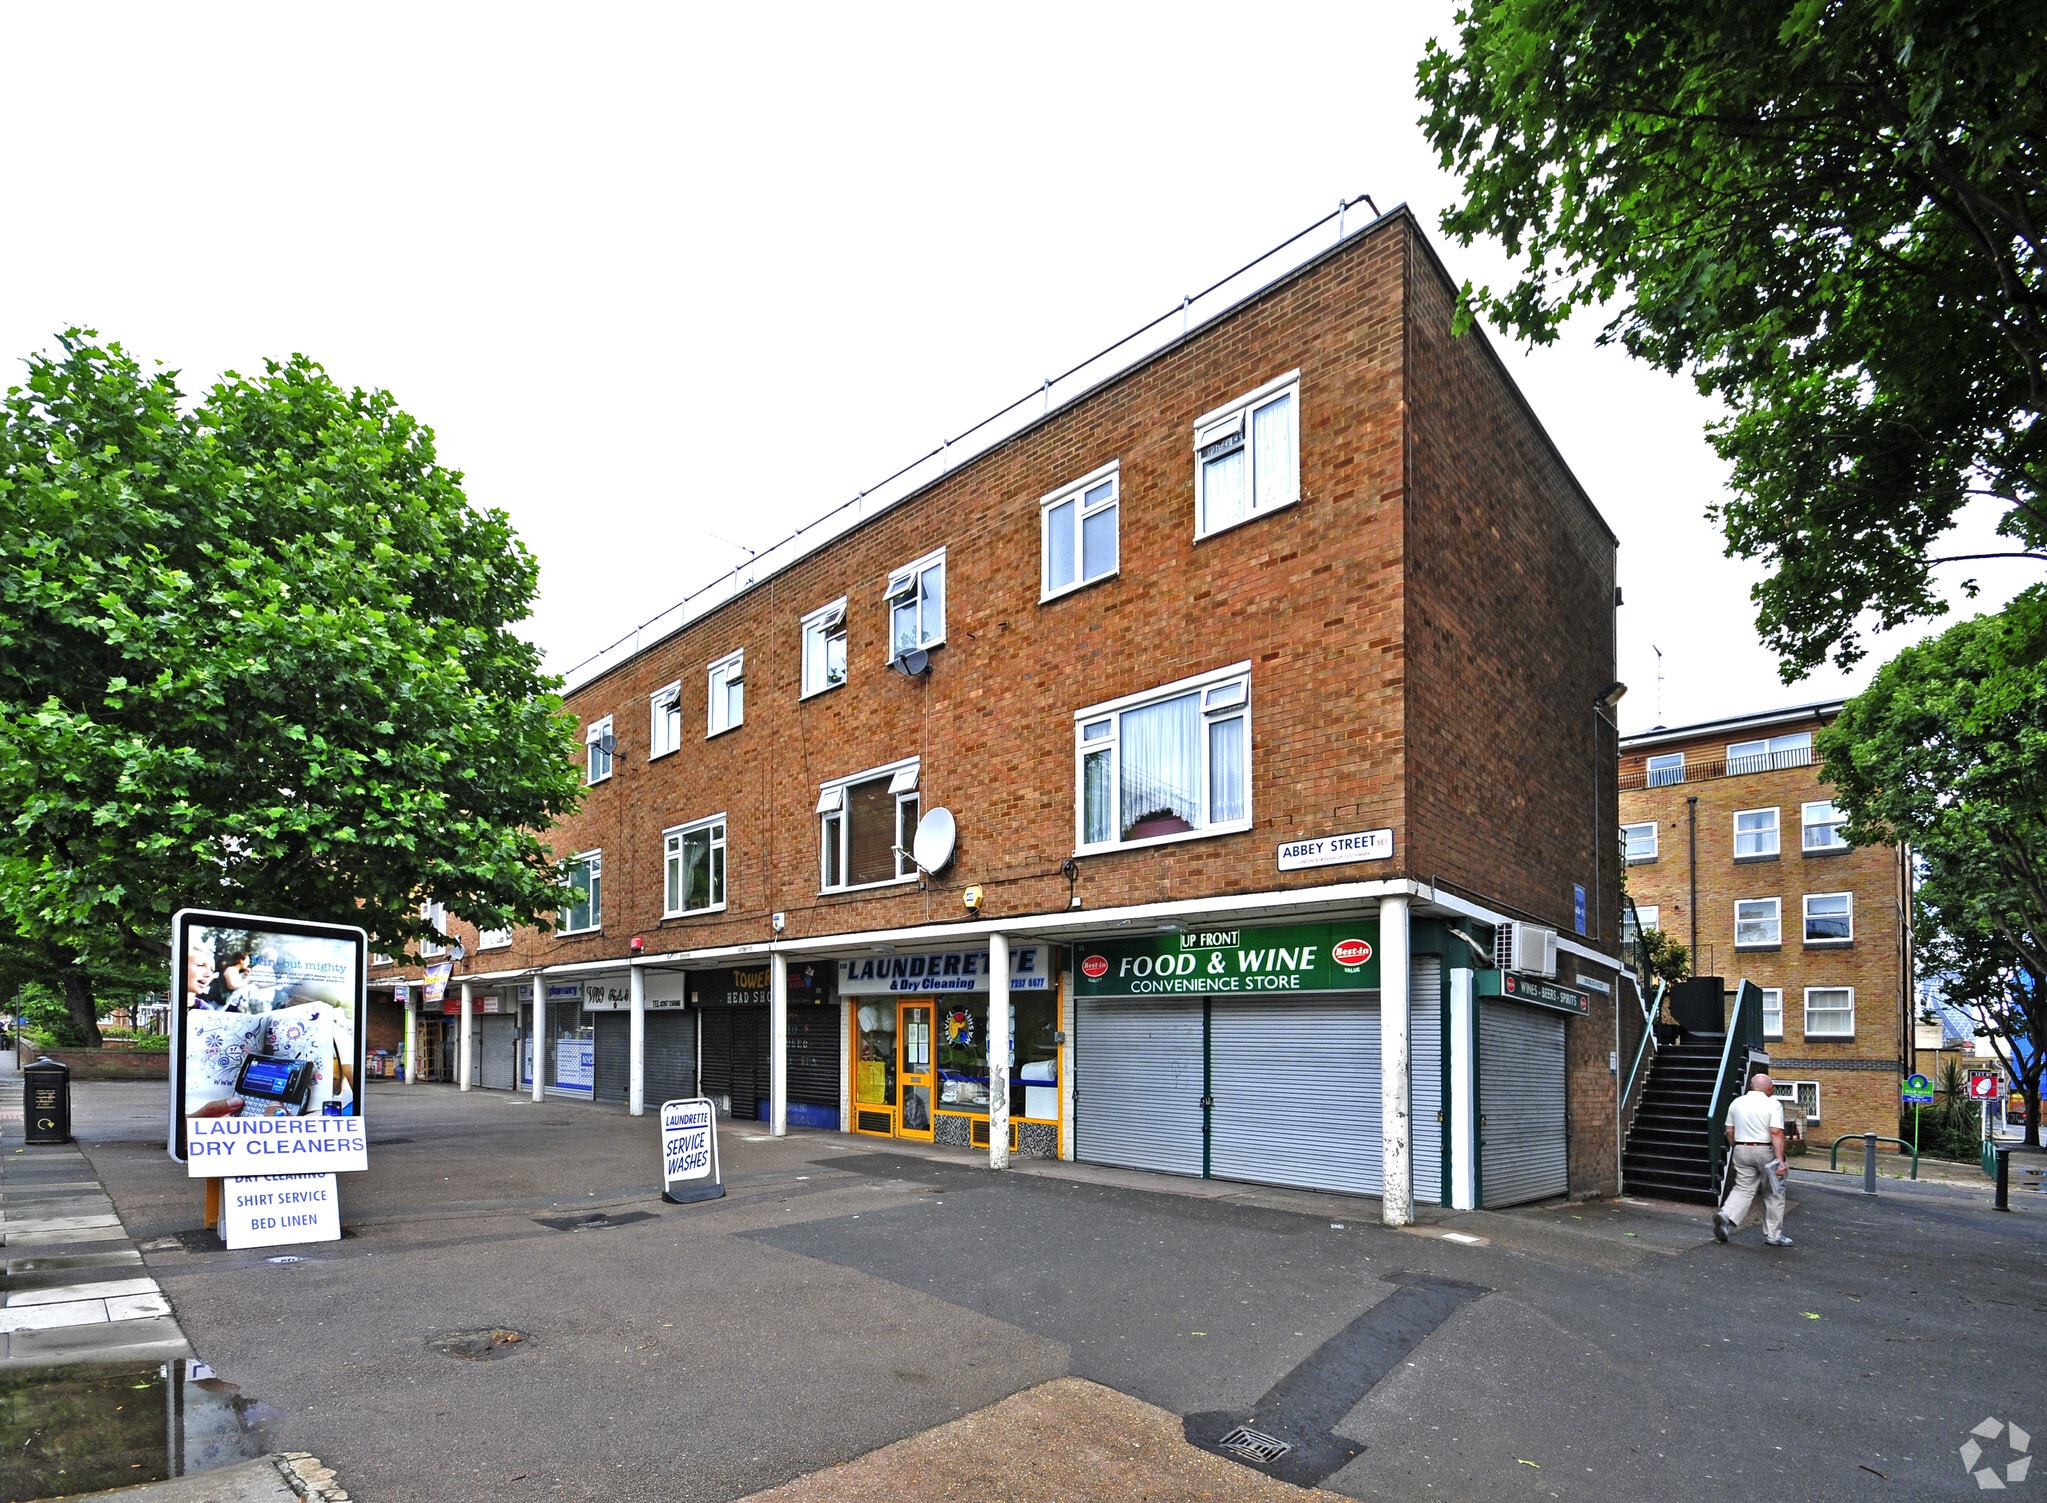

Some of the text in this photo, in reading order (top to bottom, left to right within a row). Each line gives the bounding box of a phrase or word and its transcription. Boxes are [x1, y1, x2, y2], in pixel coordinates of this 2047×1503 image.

[1283, 842, 1324, 858] ABBEY
[1331, 835, 1376, 852] STREET
[1182, 931, 1238, 947] UP FRONT
[1336, 947, 1369, 956] Best-in
[283, 958, 302, 969] but
[305, 961, 347, 974] mighty
[1119, 946, 1317, 977] FOOD & WINE
[890, 977, 975, 992] & Dry Cleaning
[1131, 975, 1300, 993] CONVENIENCE STORE
[727, 992, 749, 1004] HEAD
[1520, 980, 1537, 996] WINES
[1542, 987, 1556, 1000] BEERS
[1560, 992, 1577, 1006] SPIRITS
[195, 1119, 358, 1135] LAUNDERETTE
[666, 1112, 708, 1127] LAUNDRETTE
[190, 1138, 364, 1156] DRY CLEANERS
[667, 1132, 705, 1157] SERVICE
[668, 1150, 708, 1175] WASHES
[237, 1190, 327, 1207] SHIRT SERVICE
[251, 1214, 317, 1230] BED LINEN
